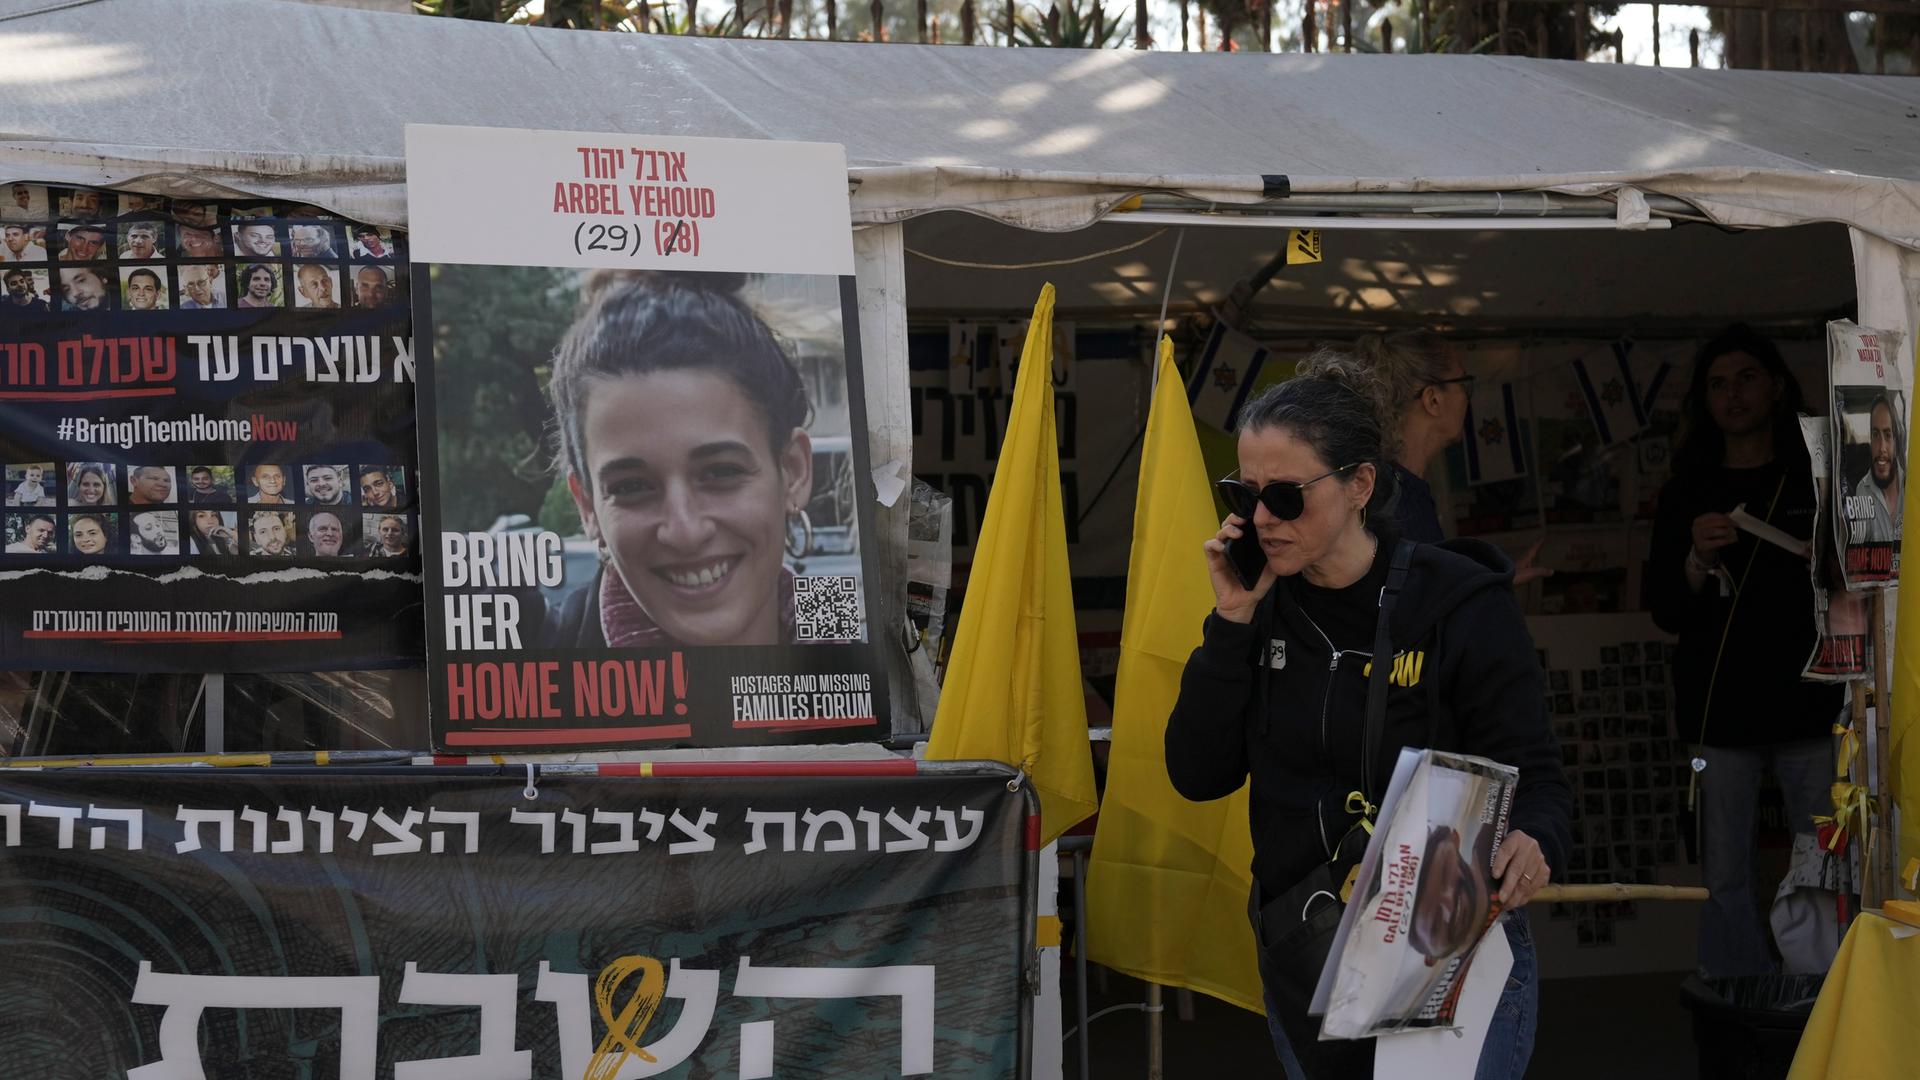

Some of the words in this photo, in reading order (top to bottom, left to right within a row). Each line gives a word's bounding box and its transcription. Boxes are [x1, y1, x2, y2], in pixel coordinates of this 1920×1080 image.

[577, 147, 625, 179] יהוד
[631, 147, 688, 182] ארבל
[553, 182, 625, 216] ARBEL
[629, 184, 715, 219] YEHOUD
[573, 222, 641, 257] (29)
[0, 342, 46, 386] חו
[57, 334, 177, 386] שכולם
[188, 336, 241, 384] עד
[253, 335, 382, 384] עוצרים
[392, 336, 416, 384] א
[57, 414, 298, 450] #BringThemHomeNow
[1846, 495, 1876, 520] BRING
[441, 530, 563, 588] BRING
[33, 610, 102, 632] והנעדרים
[107, 610, 172, 632] החטופים
[176, 609, 232, 632] להחזרת
[236, 611, 306, 632] המשפחות
[309, 611, 339, 632] מטה
[444, 594, 524, 652] HER
[447, 662, 561, 721] HOME
[574, 652, 689, 718] NOW!
[731, 675, 792, 695] HOSTAGES
[794, 675, 818, 693] AND
[820, 674, 872, 693] MISSING
[733, 694, 810, 722] FAMILIES
[812, 692, 874, 720] FORUM
[174, 803, 481, 857] הציונות
[509, 805, 720, 857] ציבור
[744, 805, 986, 855] עצומת
[128, 957, 936, 1080] השבת
